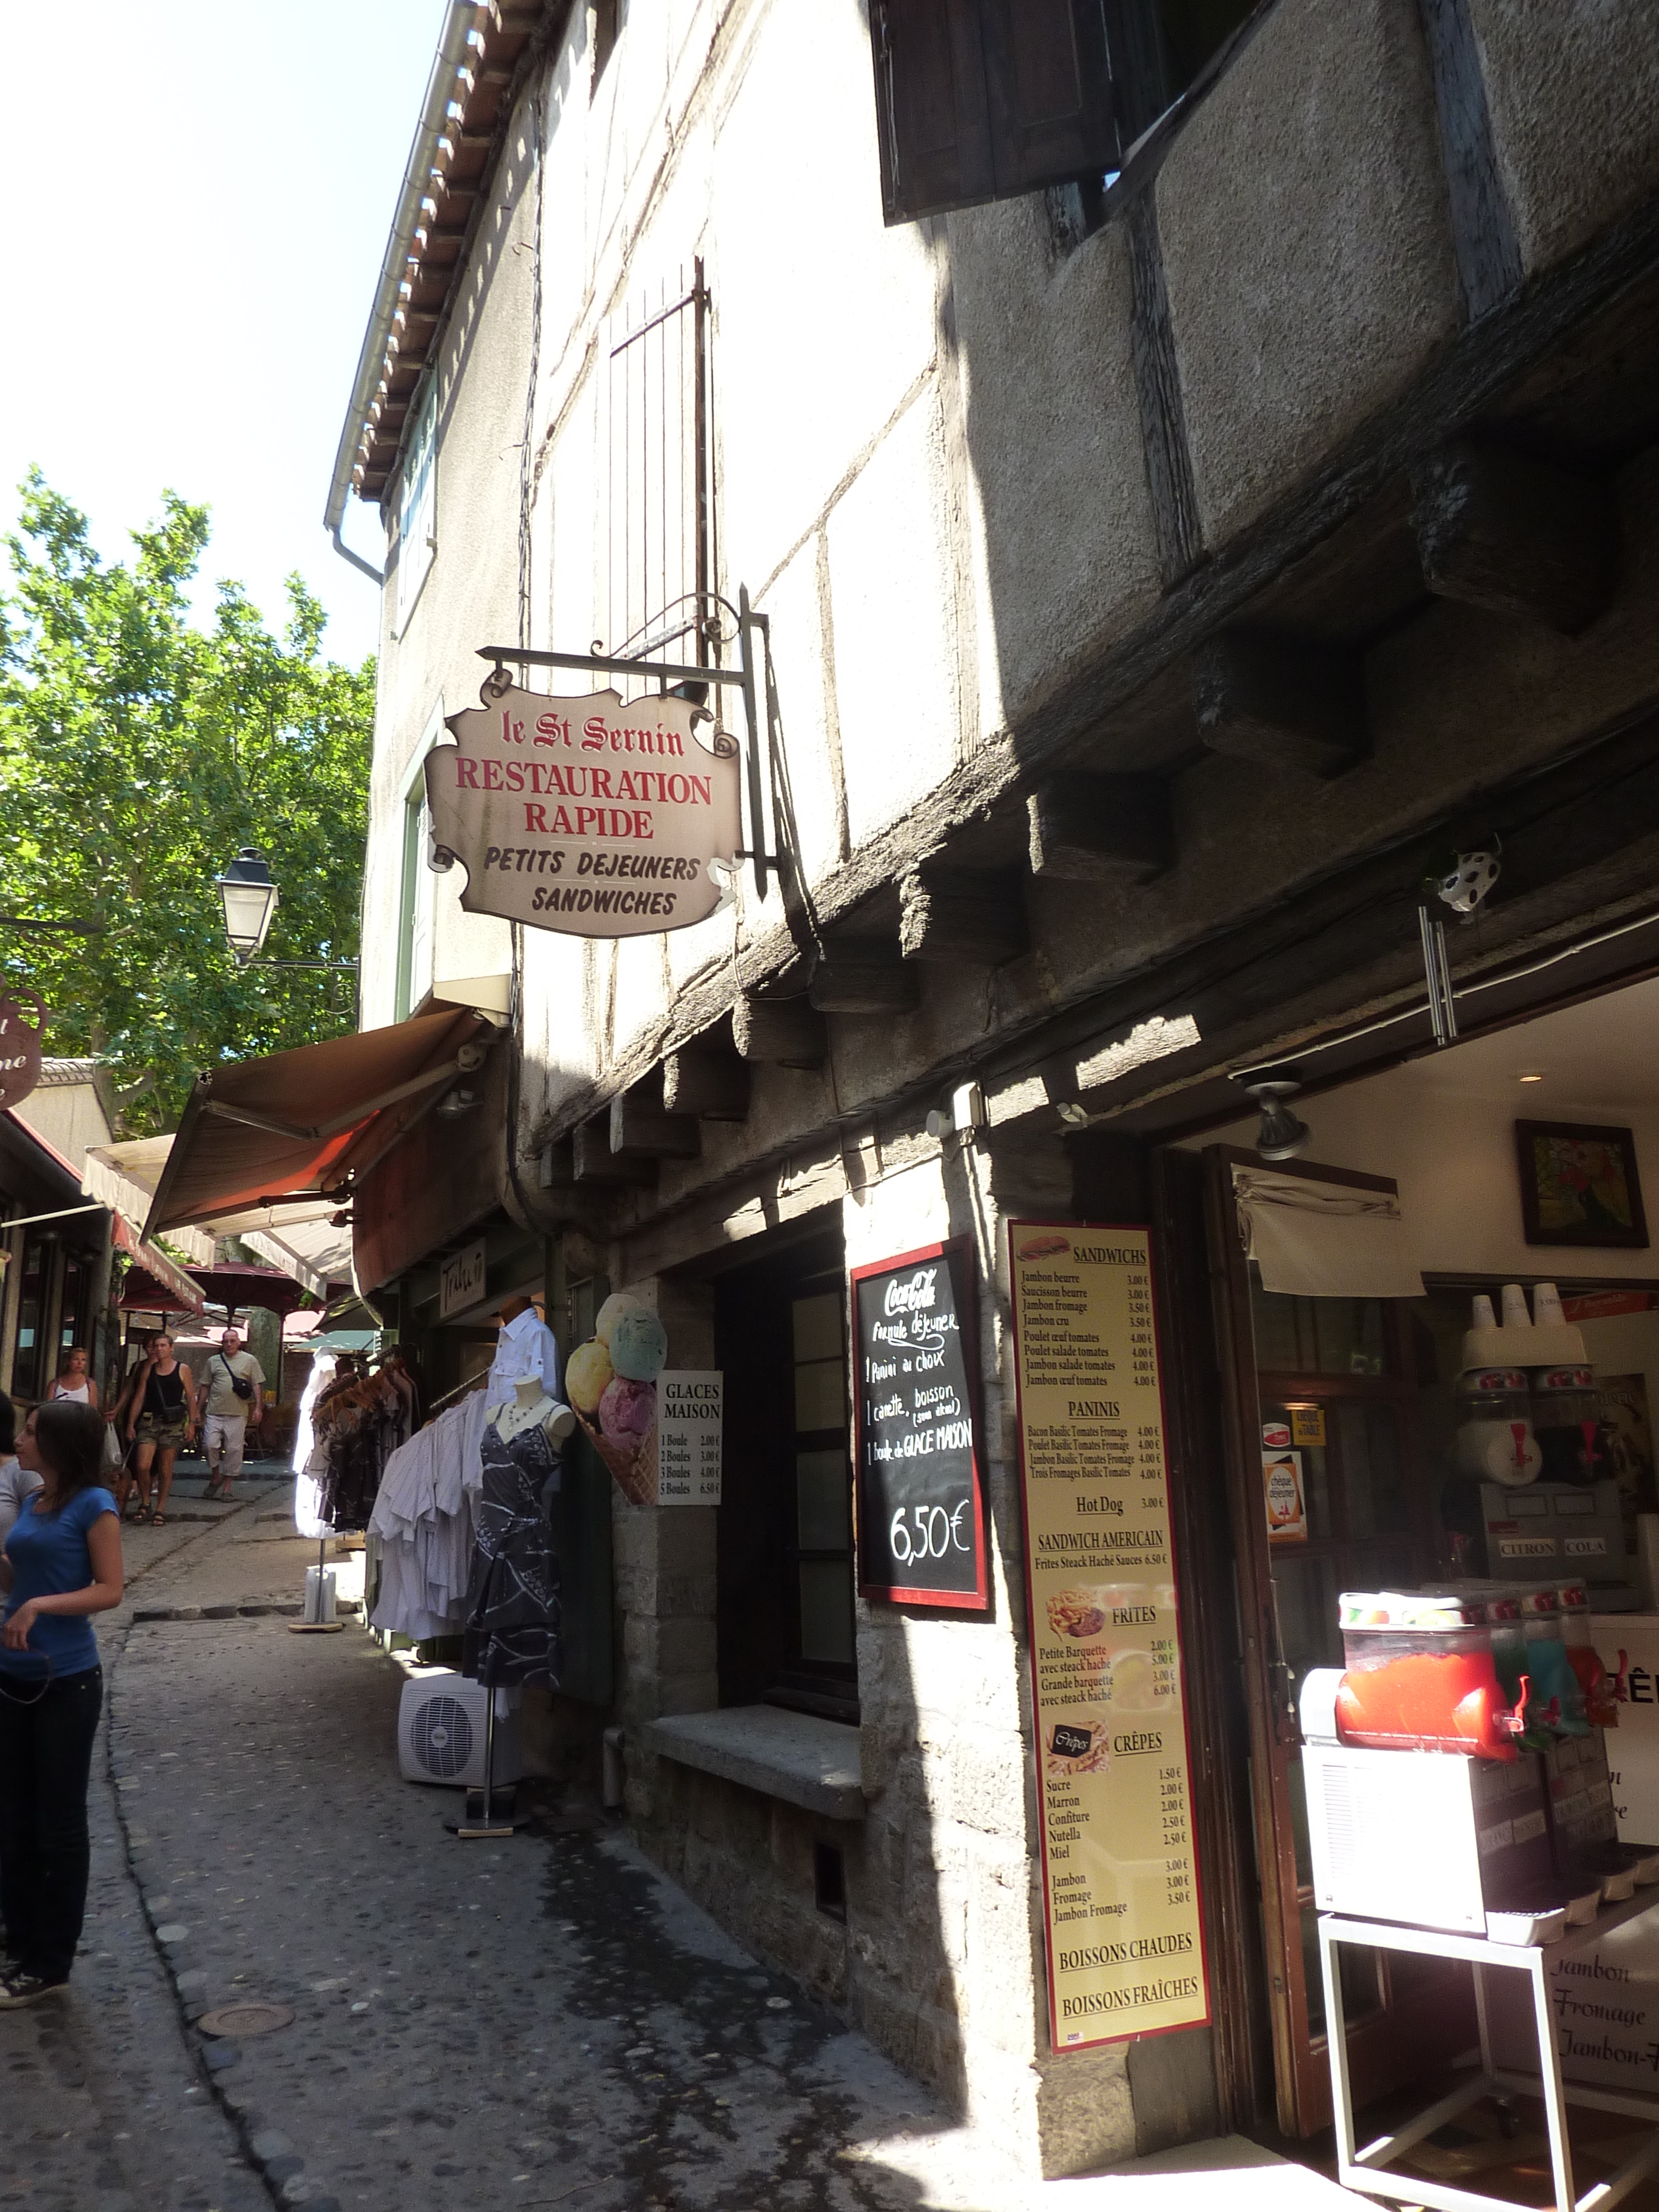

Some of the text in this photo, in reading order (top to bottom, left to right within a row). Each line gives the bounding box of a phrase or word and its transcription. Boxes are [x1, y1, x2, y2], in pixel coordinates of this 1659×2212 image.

[501, 711, 685, 757] le St Sernin
[455, 757, 712, 805] RESTAURATION
[524, 803, 654, 839] RAPIDE
[485, 846, 701, 880] PETITS DEJEUNERS
[532, 887, 677, 915] SANDWICHES
[1073, 1247, 1146, 1264] SANDWICHS
[1021, 1271, 1142, 1285] Jambon beurre 3.00
[1021, 1285, 1060, 1296] Saucisson
[1061, 1286, 1087, 1298] beurre
[1022, 1299, 1054, 1312] Jambon
[1055, 1299, 1088, 1315] fromage
[1023, 1314, 1054, 1327] Jambon
[1024, 1330, 1050, 1342] Poulet
[1068, 1333, 1099, 1342] tomates
[1024, 1344, 1050, 1356] Poulet
[1052, 1345, 1076, 1356] salade
[1078, 1347, 1108, 1357] tomates
[903, 1359, 912, 1372] au
[1025, 1358, 1057, 1372] Jambon
[1059, 1359, 1083, 1370] salade
[1085, 1361, 1115, 1370] tomates
[1026, 1373, 1057, 1387] Jambon
[1076, 1376, 1107, 1386] tomates
[666, 1384, 719, 1399] GLACES
[915, 1386, 954, 1408] boisson
[665, 1404, 720, 1418] MAISON
[1068, 1401, 1120, 1416] PANINIS
[662, 1433, 714, 1446] 1 Boule 2.00
[894, 1441, 903, 1458] de
[904, 1430, 934, 1457] GLACE
[937, 1418, 973, 1450] MAISON
[1028, 1426, 1048, 1436] Bacon
[1049, 1426, 1071, 1436] Basilic
[1071, 1426, 1099, 1436] Tomates
[1100, 1426, 1128, 1440] Fromage
[1028, 1439, 1050, 1450] Poulet
[1051, 1438, 1072, 1450] Basilic
[1073, 1439, 1101, 1450] Tomates
[1102, 1439, 1130, 1454] Fromage
[661, 1451, 665, 1462] 2
[667, 1450, 690, 1462] Boules
[1030, 1453, 1055, 1465] Jambon
[1056, 1453, 1078, 1464] Basilic
[1079, 1454, 1106, 1464] Tomates
[1107, 1454, 1134, 1467] Fromage
[661, 1466, 714, 1478] 3 Boules 4.00
[1030, 1466, 1048, 1478] Trois
[1049, 1467, 1081, 1482] Fromages
[1082, 1466, 1102, 1478] Basilic
[1104, 1467, 1131, 1477] Tomates
[660, 1483, 665, 1495] 5
[666, 1482, 690, 1495] Boules
[1076, 1496, 1098, 1512] Hot
[1100, 1496, 1123, 1516] Dog
[1038, 1530, 1163, 1550] SANDWICH AMERICAIN
[1034, 1554, 1161, 1569] Frites Steack Haché Sauces 6.50
[1113, 1606, 1156, 1623] FRITES
[1039, 1640, 1167, 1660] Petite Barquette 2.00
[1040, 1664, 1058, 1674] avec
[1060, 1659, 1085, 1672] steack
[1087, 1658, 1111, 1670] haché
[1042, 1671, 1169, 1691] Grande barquette 3.00
[1040, 1684, 1170, 1706] avec steack haché 6.00
[1114, 1731, 1162, 1752] CRÊPES
[1047, 1768, 1175, 1792] Sucre 1.50
[1047, 1784, 1176, 1809] Marron 2.00
[1048, 1800, 1178, 1826] Confiture 2.00
[1049, 1817, 1179, 1842] Nutella 2.50
[1049, 1833, 1180, 1860] Miel 2.50
[1051, 1860, 1182, 1891] Jambon 3.00
[1053, 1876, 1182, 1905] Fromage 3.00
[1054, 1893, 1184, 1925] Jambon Fromage 3.50
[1059, 1932, 1192, 1969] BOISSONS CHAUDES
[1062, 1976, 1198, 2017] BOISSONS FRAÎCHES
